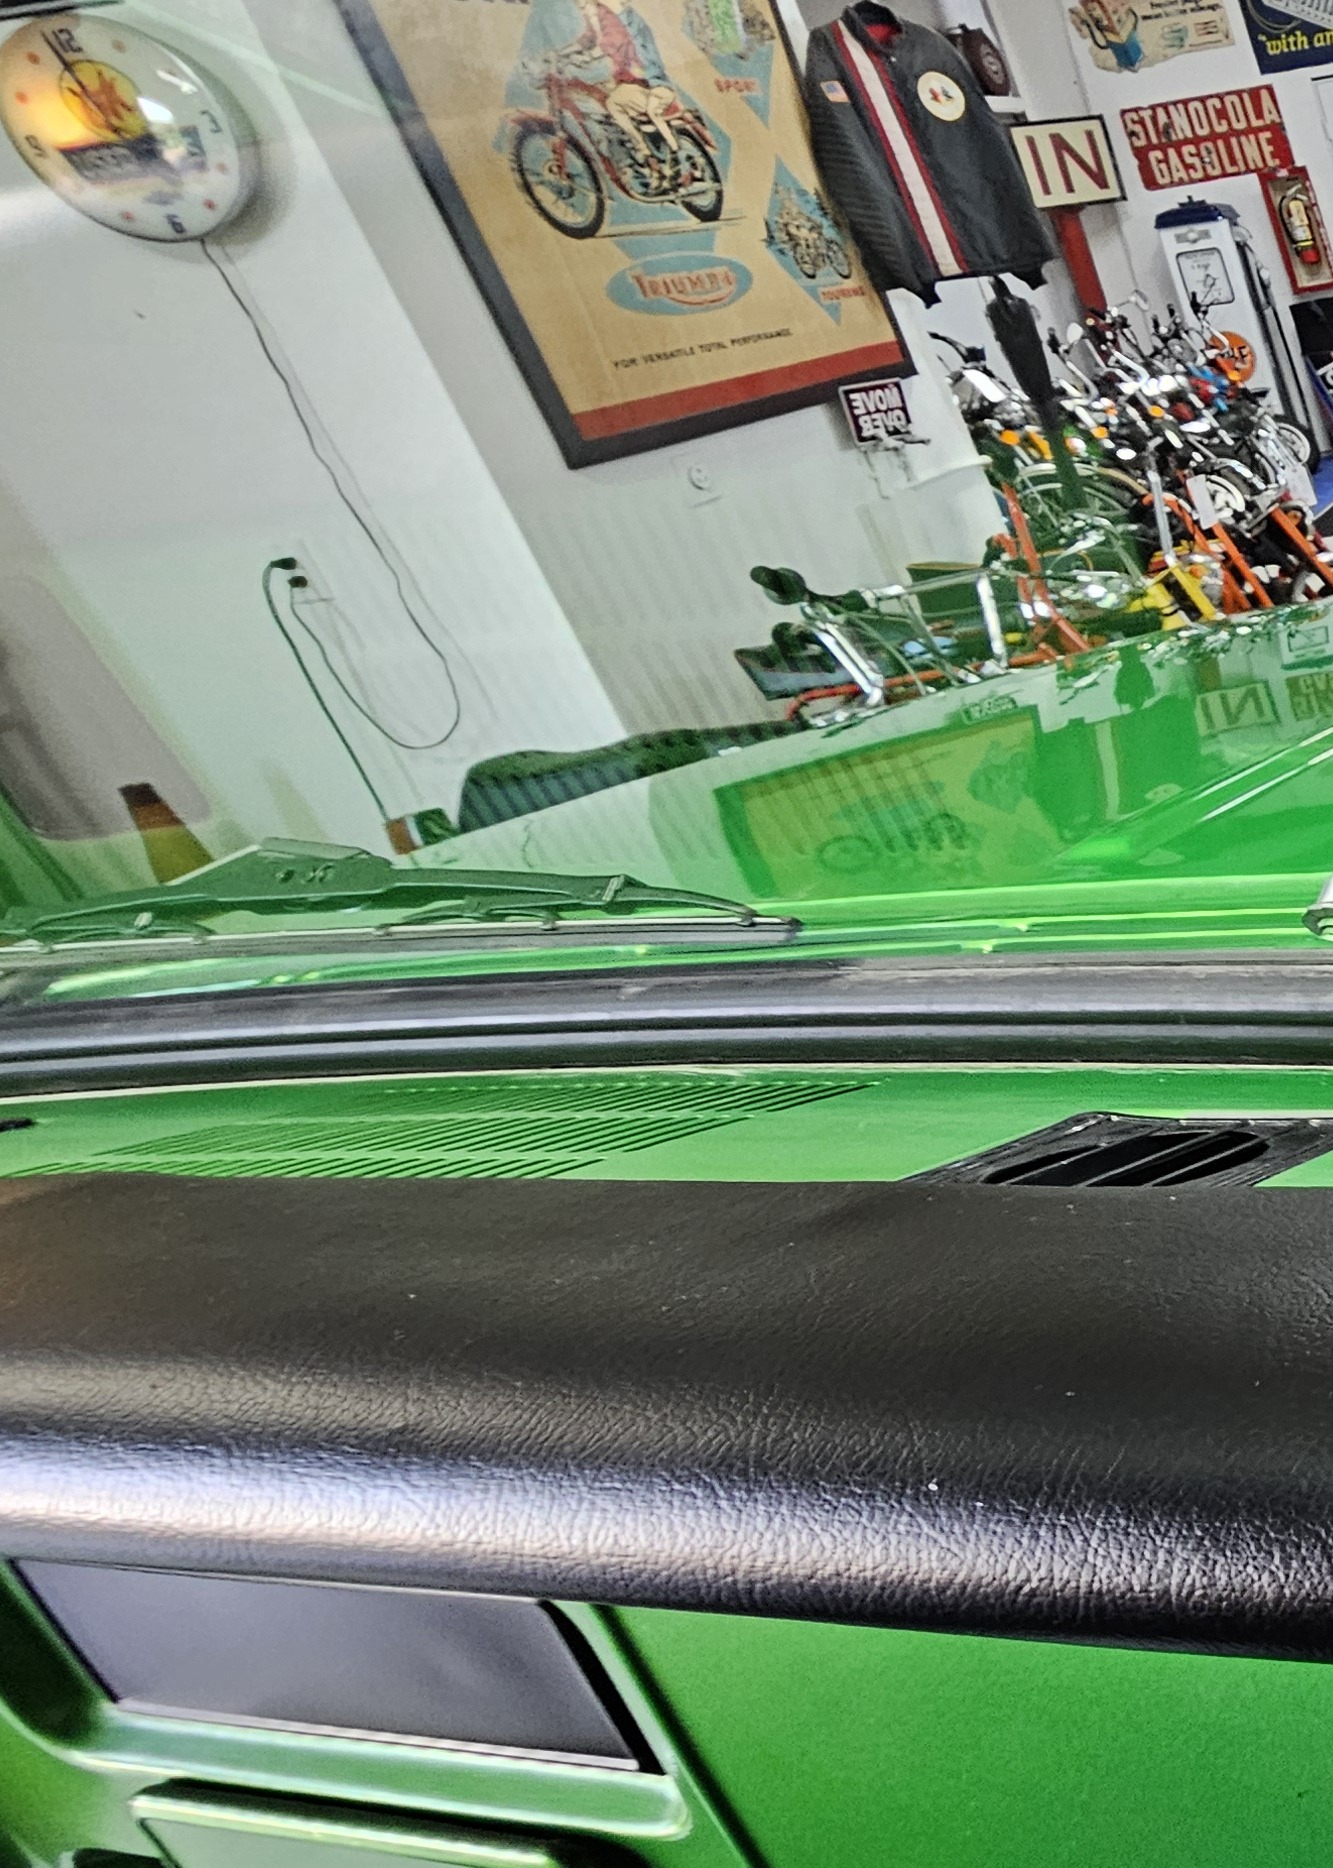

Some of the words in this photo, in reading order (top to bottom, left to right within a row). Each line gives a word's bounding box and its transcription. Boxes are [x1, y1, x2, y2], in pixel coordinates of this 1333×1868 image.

[51, 27, 84, 54] 12
[1123, 88, 1282, 148] STANOCOLA
[1025, 128, 1111, 196] IN
[1148, 131, 1281, 186] GASOLINE
[630, 265, 735, 298] TRIUMPH
